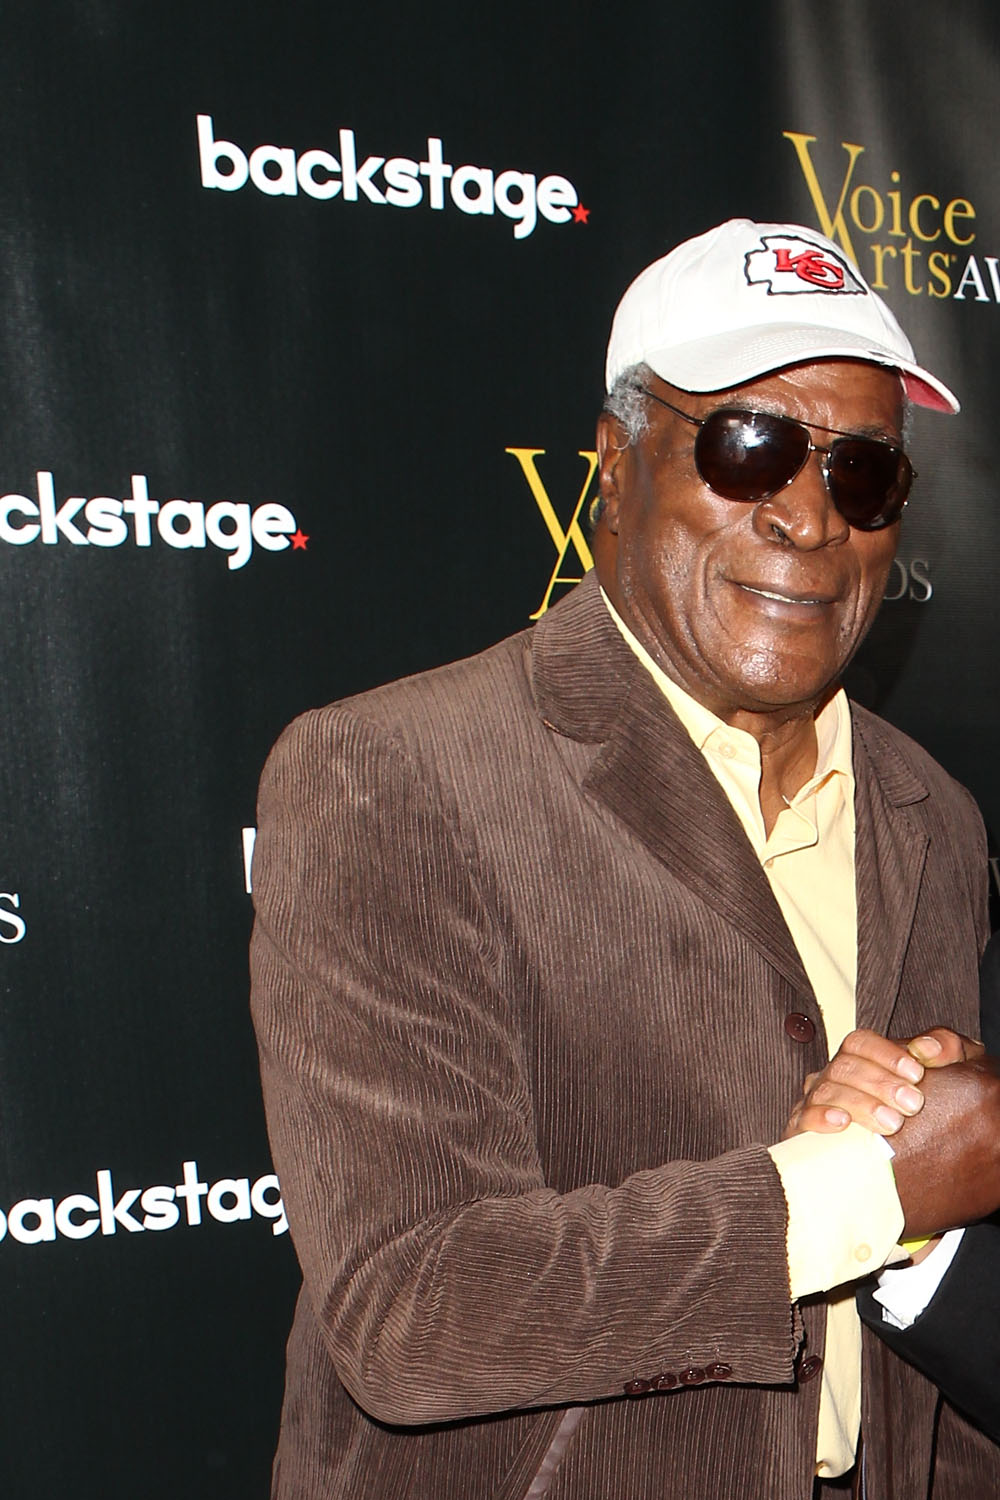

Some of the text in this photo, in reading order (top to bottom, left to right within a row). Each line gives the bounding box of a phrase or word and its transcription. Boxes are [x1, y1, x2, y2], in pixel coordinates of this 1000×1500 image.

[197, 114, 579, 240] backstage
[783, 131, 976, 246] Voice
[0, 1160, 289, 1245] ackstag
